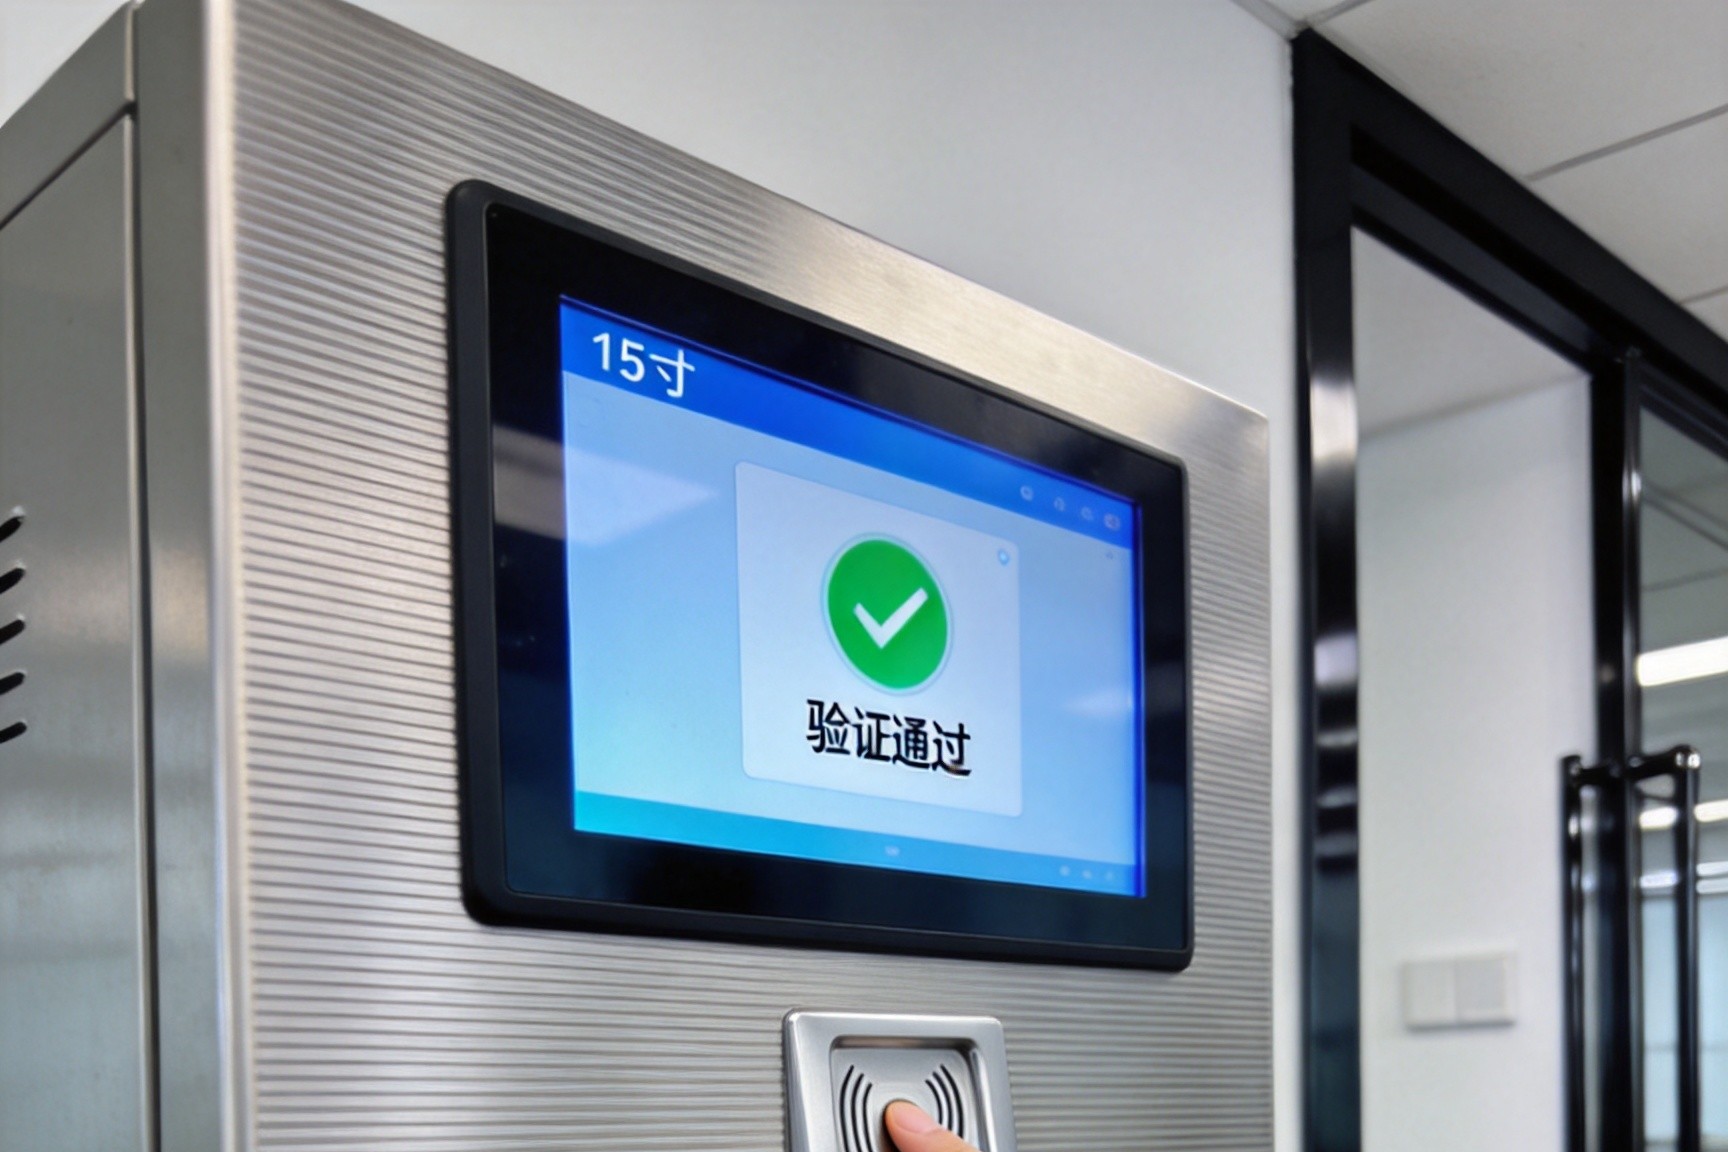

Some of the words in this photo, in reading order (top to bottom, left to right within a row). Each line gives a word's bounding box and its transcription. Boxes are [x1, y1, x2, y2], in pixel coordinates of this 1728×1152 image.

[593, 332, 696, 398] 15寸
[806, 698, 972, 776] 验证通过
